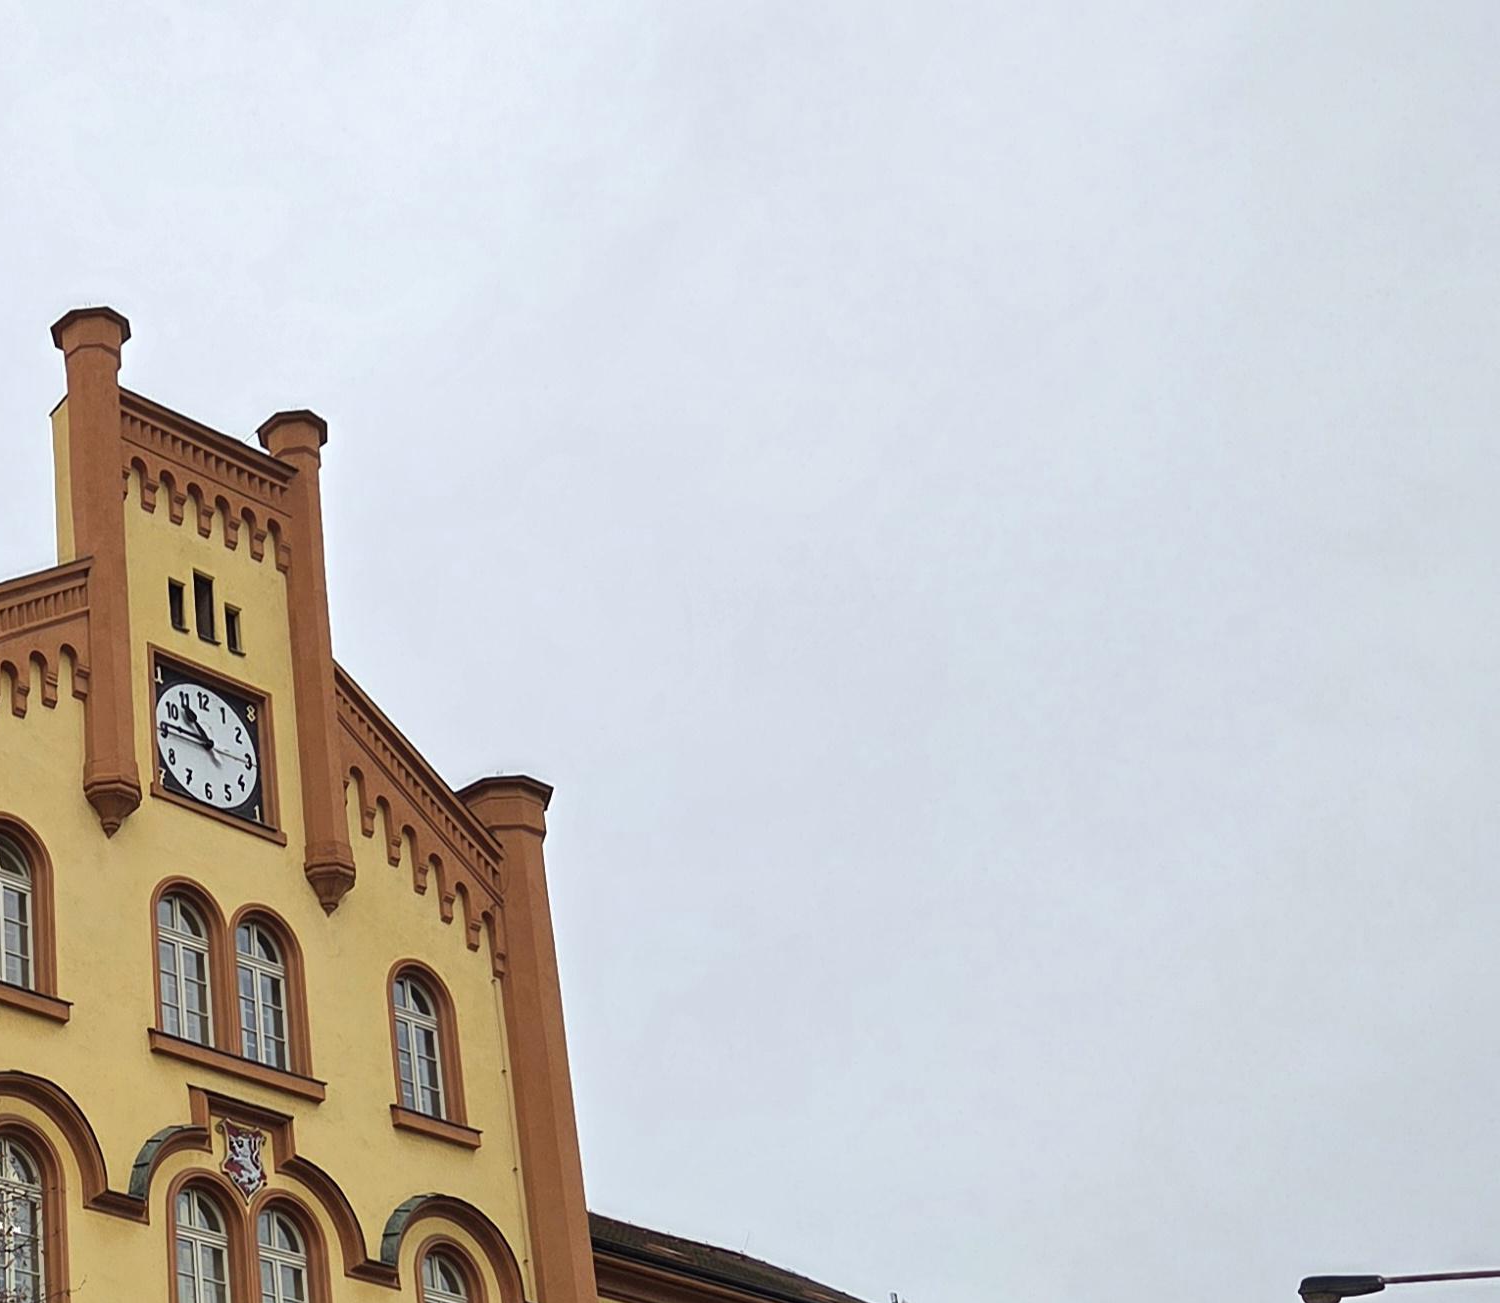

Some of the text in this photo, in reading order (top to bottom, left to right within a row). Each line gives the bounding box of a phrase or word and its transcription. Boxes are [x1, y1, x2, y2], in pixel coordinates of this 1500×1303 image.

[154, 666, 164, 684] 1
[165, 701, 179, 720] 10
[197, 691, 210, 712] 12
[220, 707, 226, 724] 1
[246, 705, 256, 722] 8
[160, 721, 169, 738] 9
[235, 726, 242, 744] 2
[168, 748, 176, 766] 8
[244, 753, 253, 770] 3
[185, 768, 193, 785] 7
[238, 774, 245, 792] 4
[204, 782, 213, 800] 6
[224, 784, 232, 802] 5
[253, 805, 260, 821] 1
